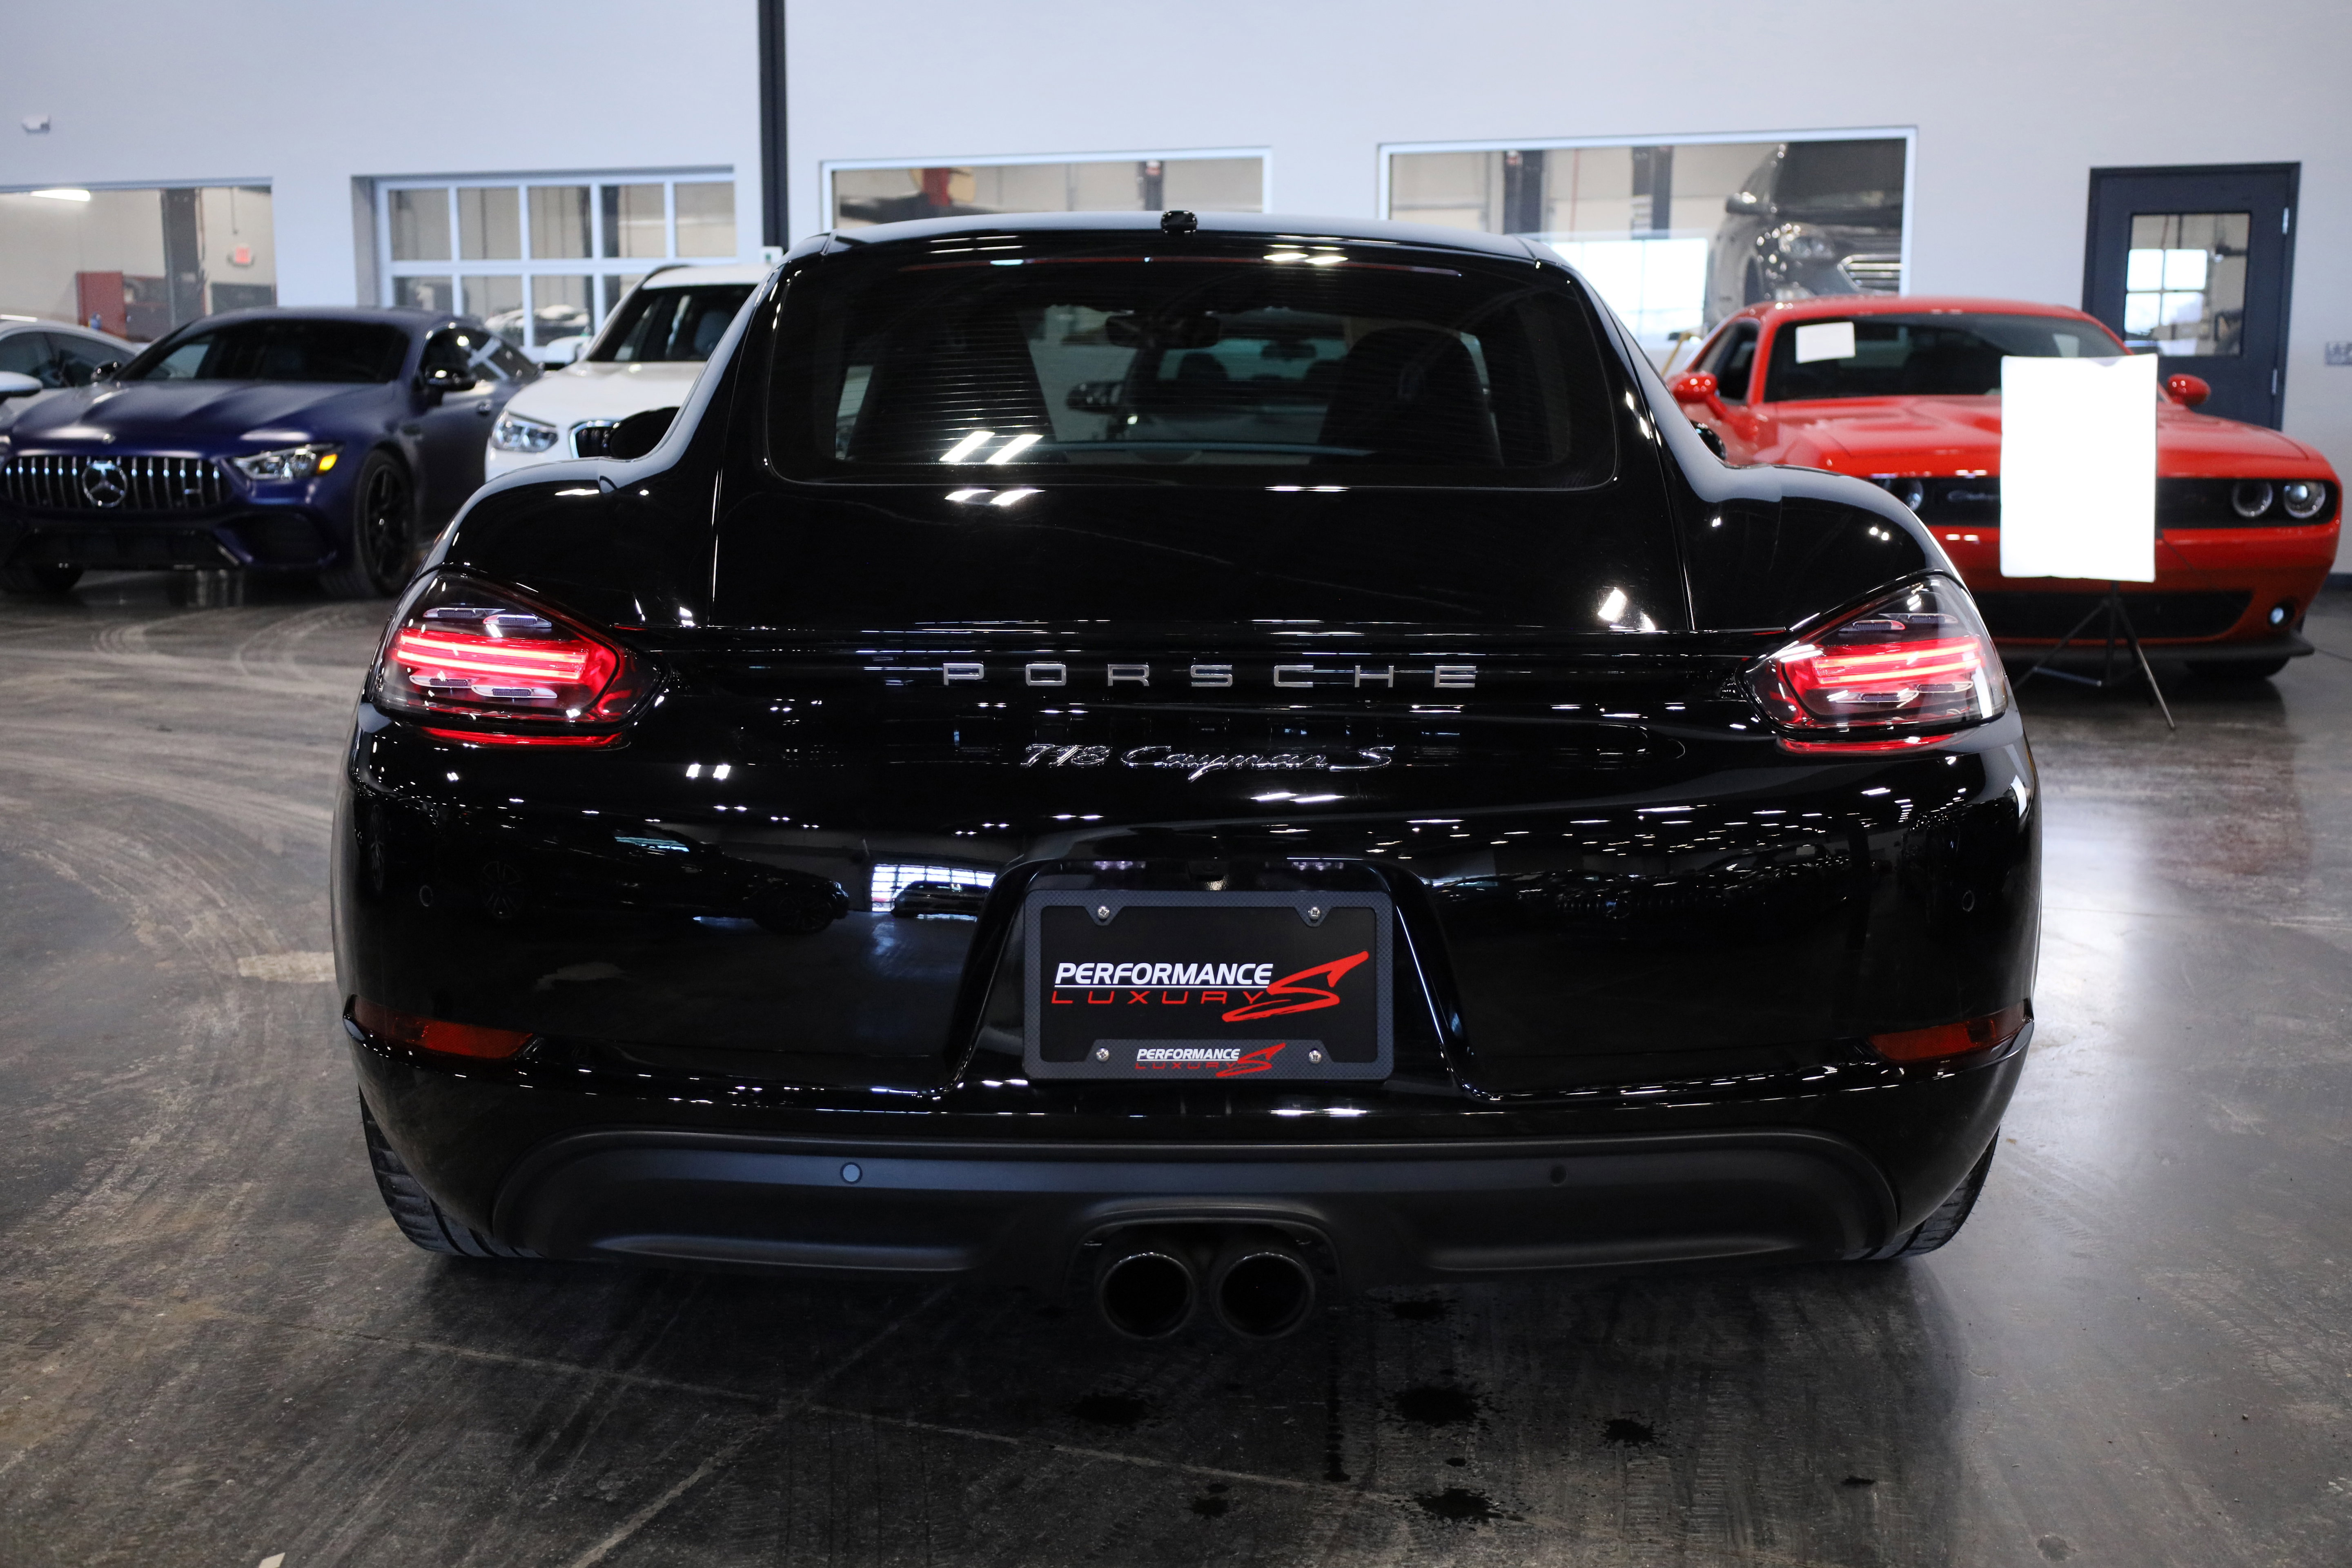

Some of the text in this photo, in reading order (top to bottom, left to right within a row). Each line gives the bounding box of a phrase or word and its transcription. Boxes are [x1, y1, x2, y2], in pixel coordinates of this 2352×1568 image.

[942, 662, 1477, 688] PORSCHE
[1020, 743, 1396, 783] 718 Cayman S
[1055, 962, 1273, 985] PERFORMANCE
[1051, 991, 1264, 1005] LUXURY
[1137, 1048, 1241, 1060] PERFORMANCE
